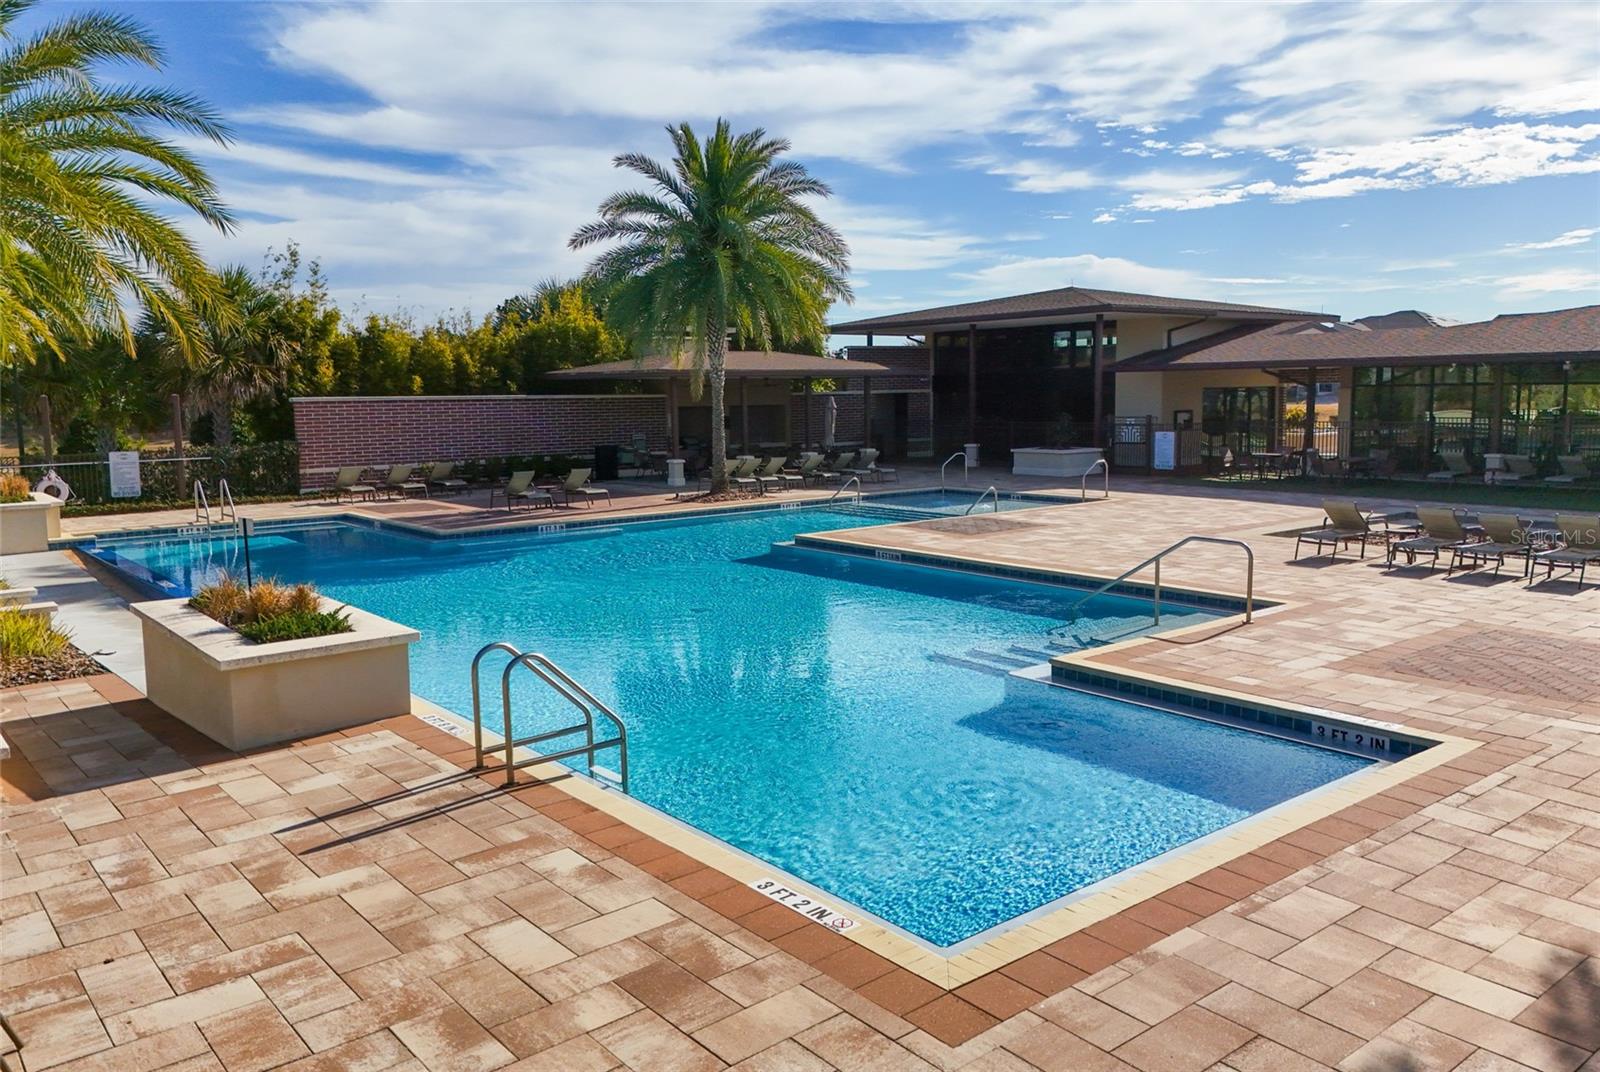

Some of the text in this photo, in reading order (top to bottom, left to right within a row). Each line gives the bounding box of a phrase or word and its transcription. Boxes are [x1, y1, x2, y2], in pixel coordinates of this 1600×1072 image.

[1317, 726, 1386, 750] 3 FT 2 IN
[756, 881, 775, 890] 3
[791, 899, 811, 910] 2
